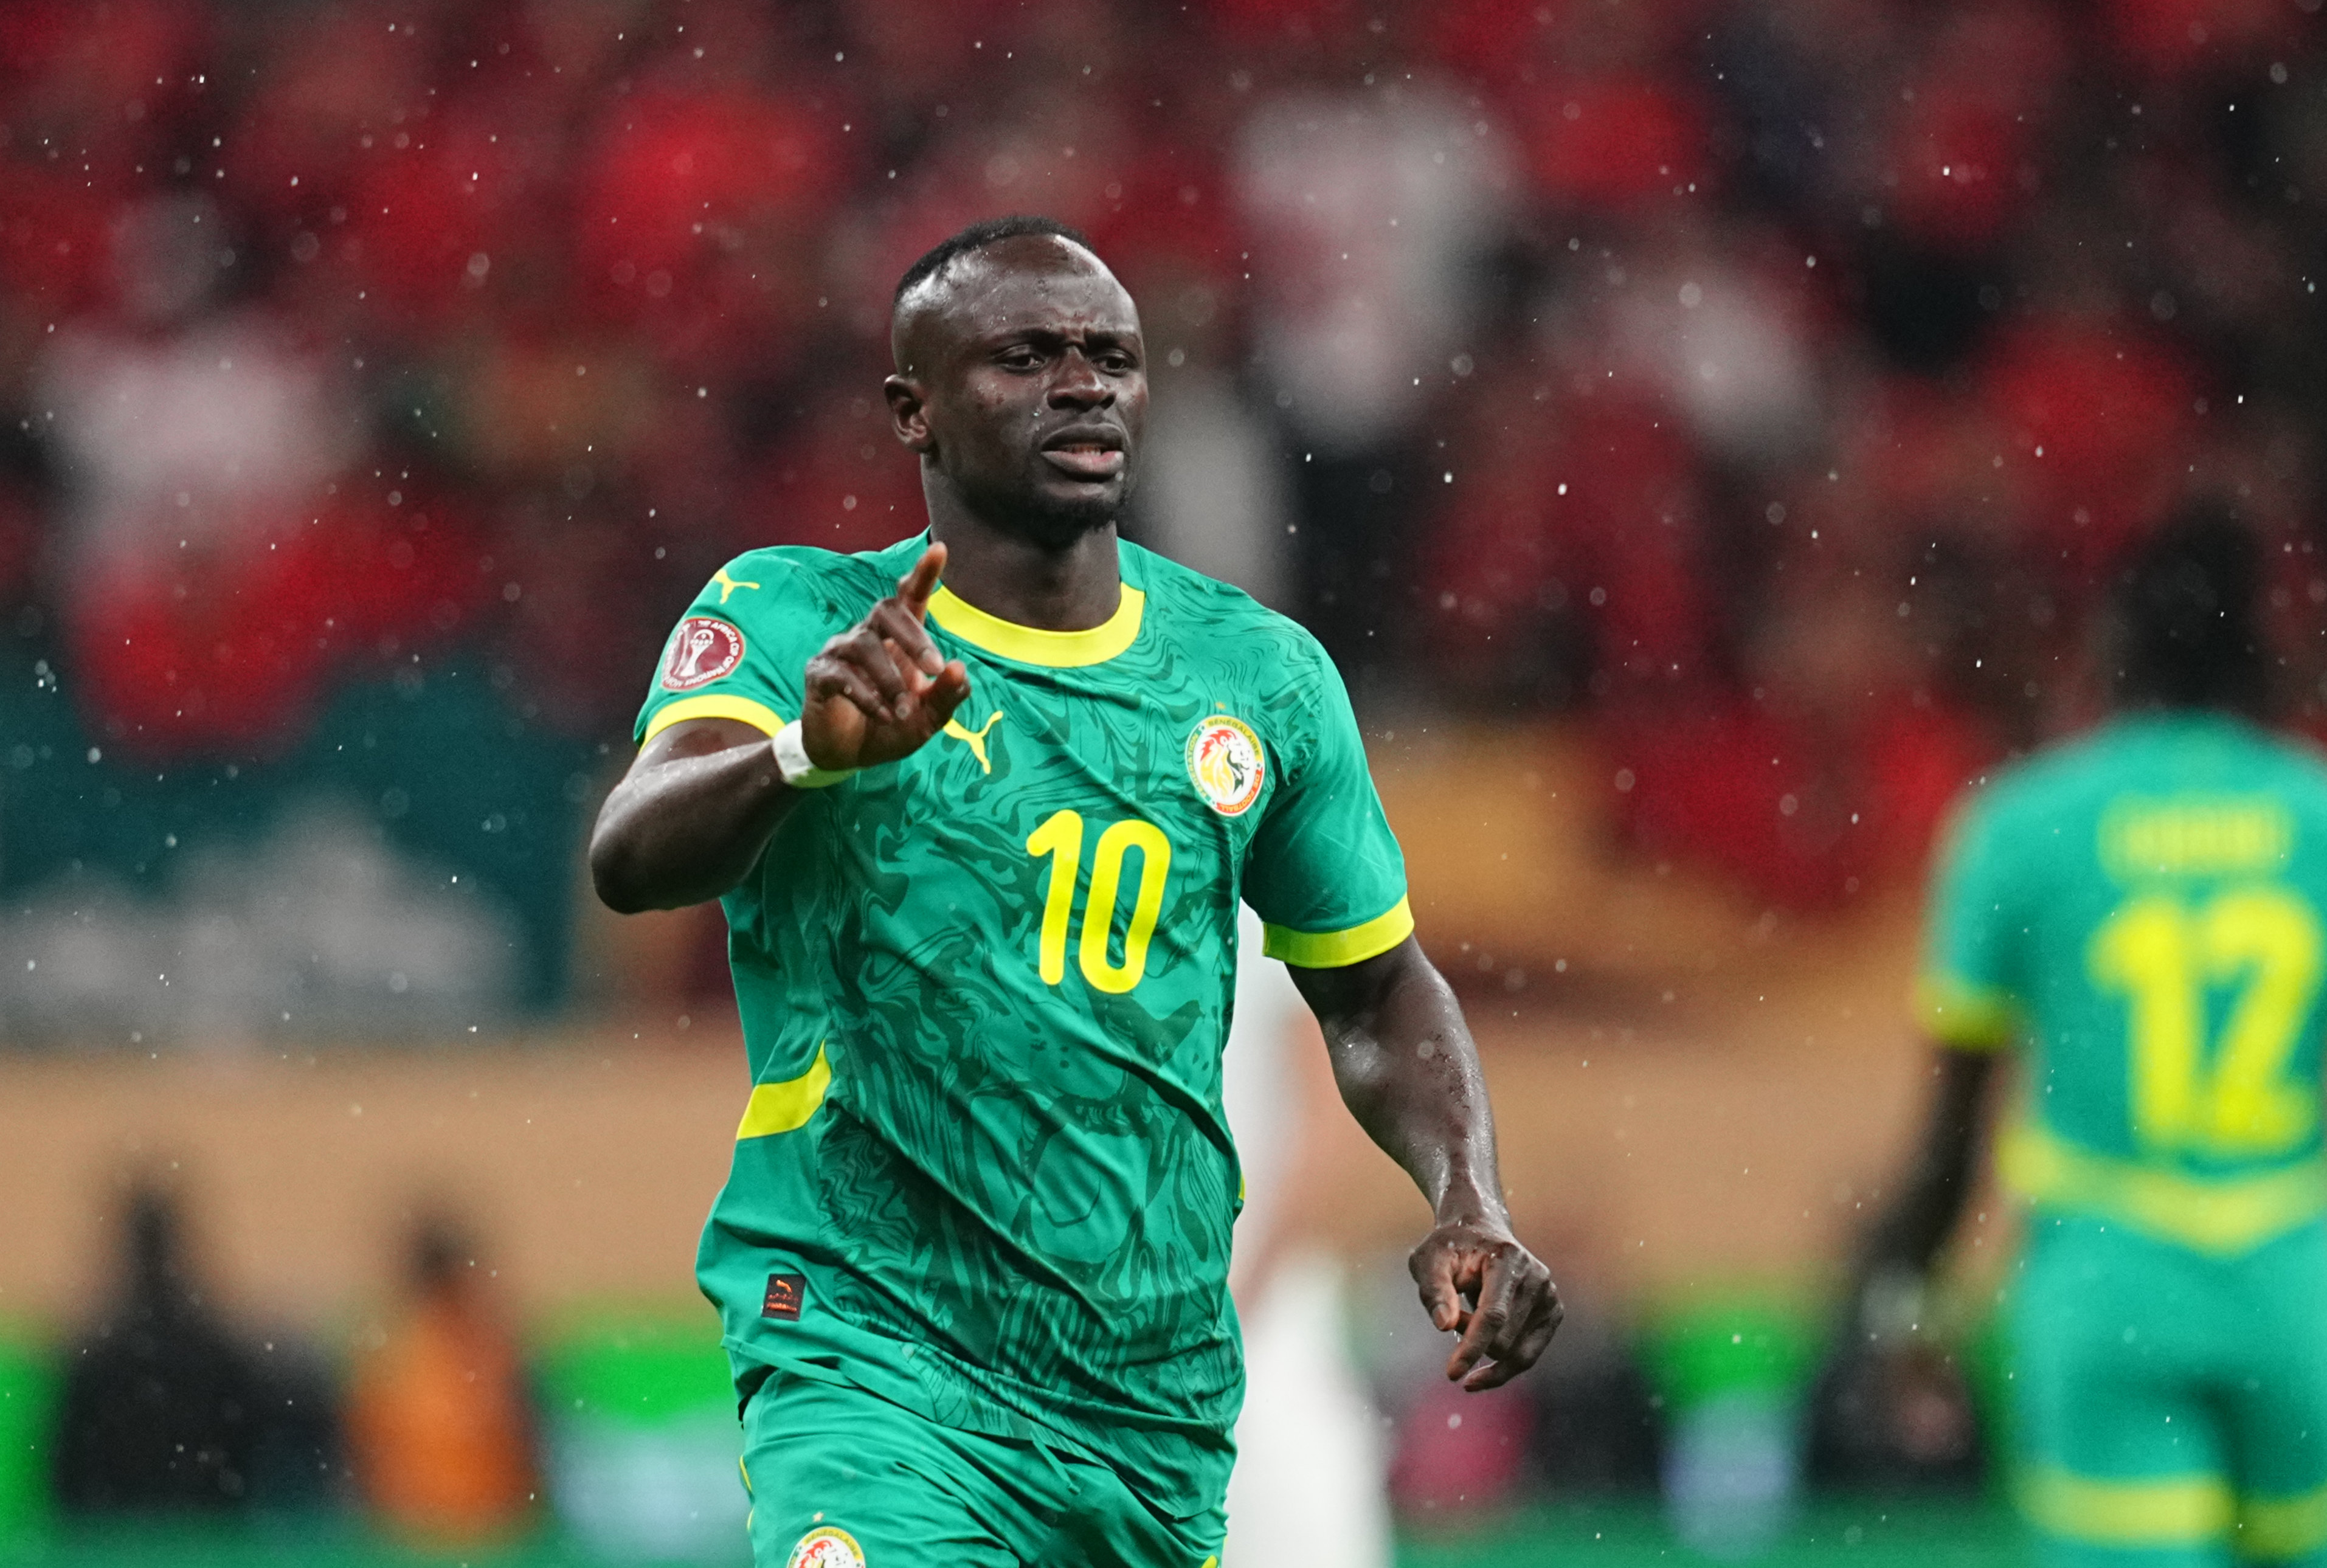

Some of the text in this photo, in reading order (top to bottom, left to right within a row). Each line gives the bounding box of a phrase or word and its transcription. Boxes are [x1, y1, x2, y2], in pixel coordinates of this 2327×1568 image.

[711, 621, 738, 643] AFRICA
[1220, 789, 1256, 812] FOOTBALL
[1026, 809, 1171, 993] 10
[2087, 891, 2320, 1149] 12
